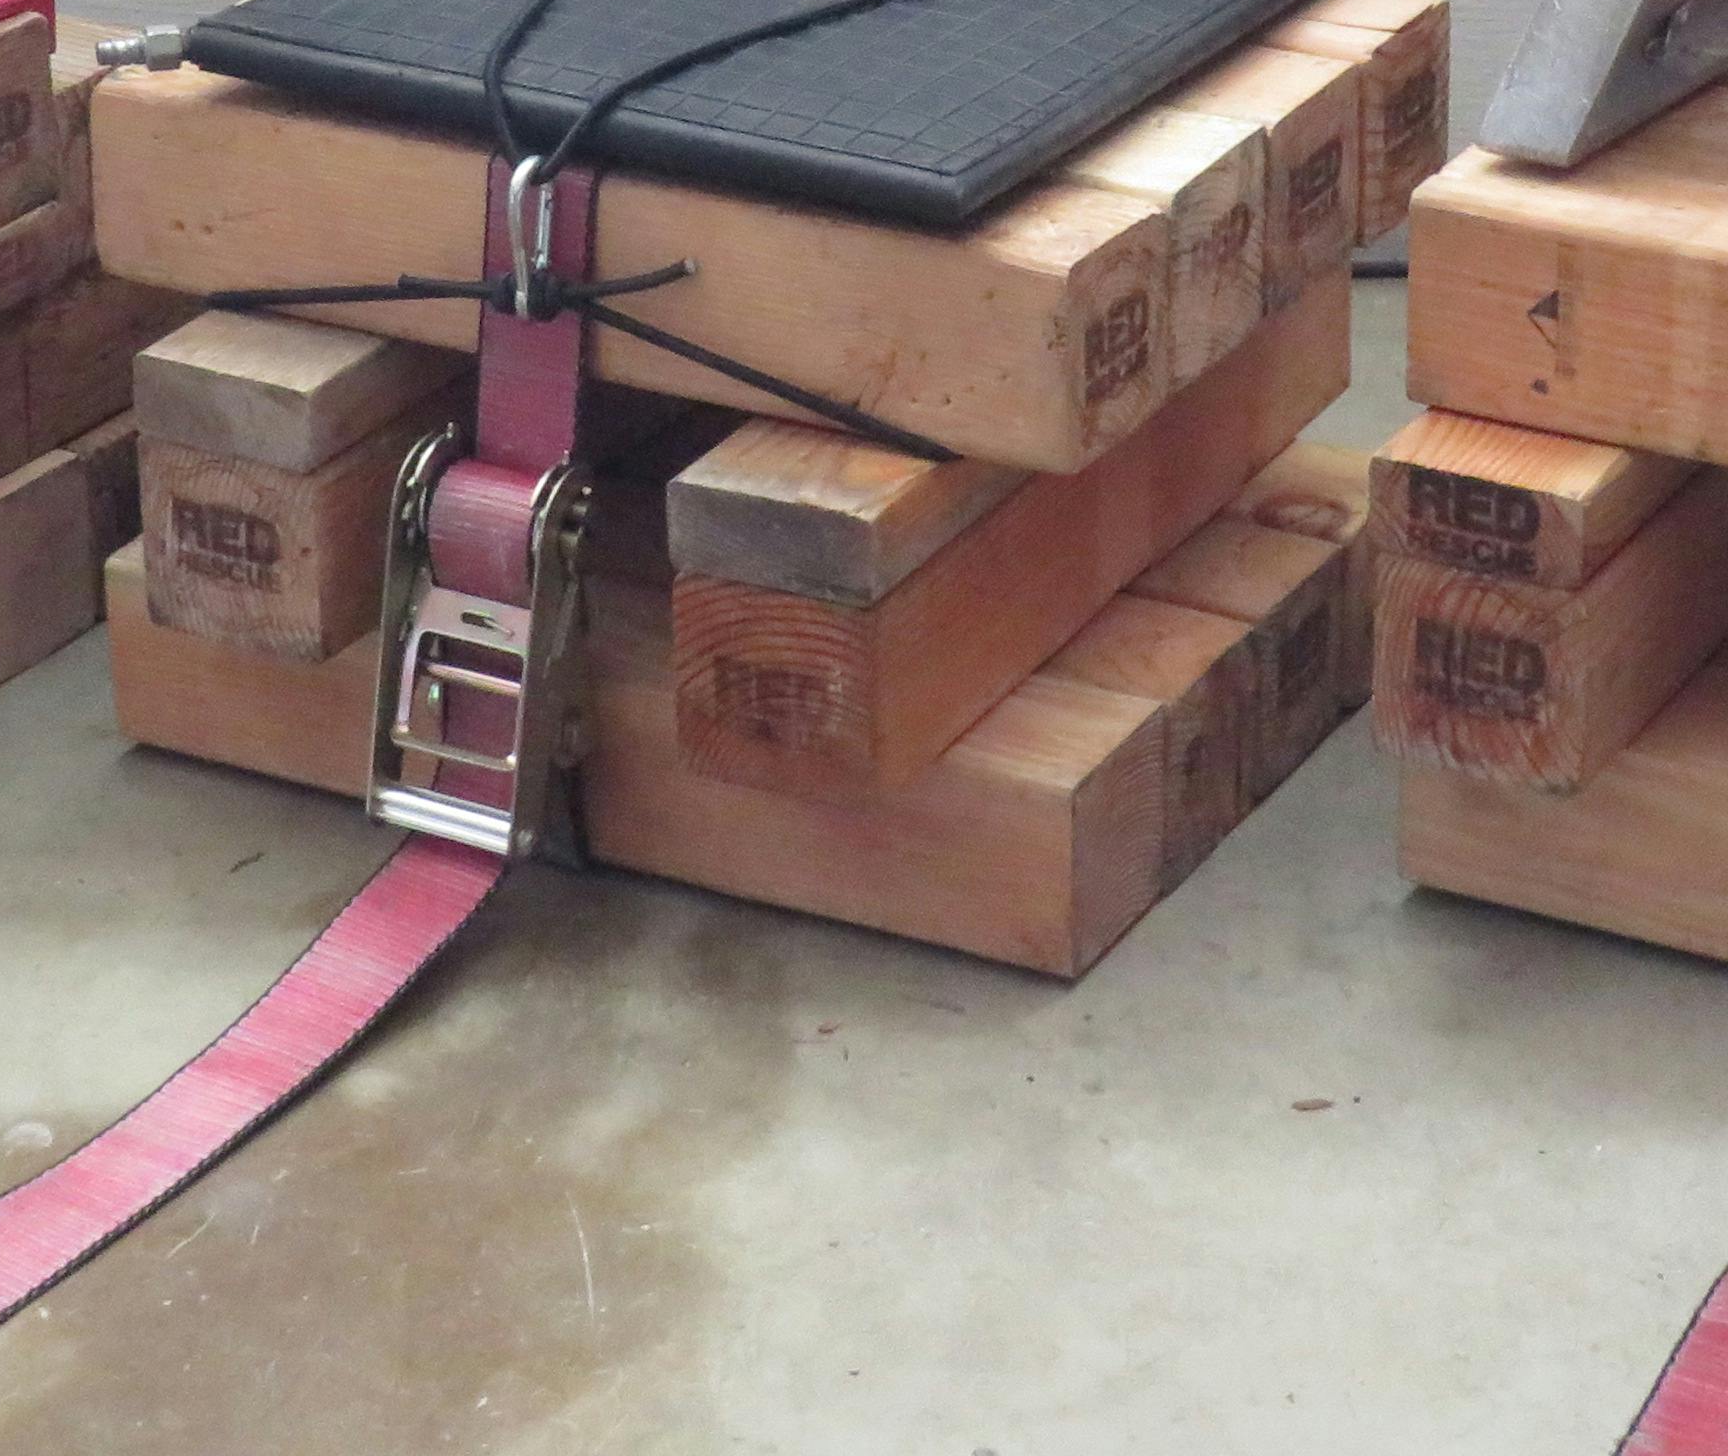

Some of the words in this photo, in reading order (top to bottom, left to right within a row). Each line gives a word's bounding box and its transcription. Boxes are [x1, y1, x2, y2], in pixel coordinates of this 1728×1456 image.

[1085, 289, 1149, 382] RED
[172, 496, 282, 566] RED
[1408, 466, 1540, 544] RED
[176, 551, 282, 595] RESCUE
[1406, 521, 1538, 577] RESCUE
[1415, 617, 1547, 696] RED
